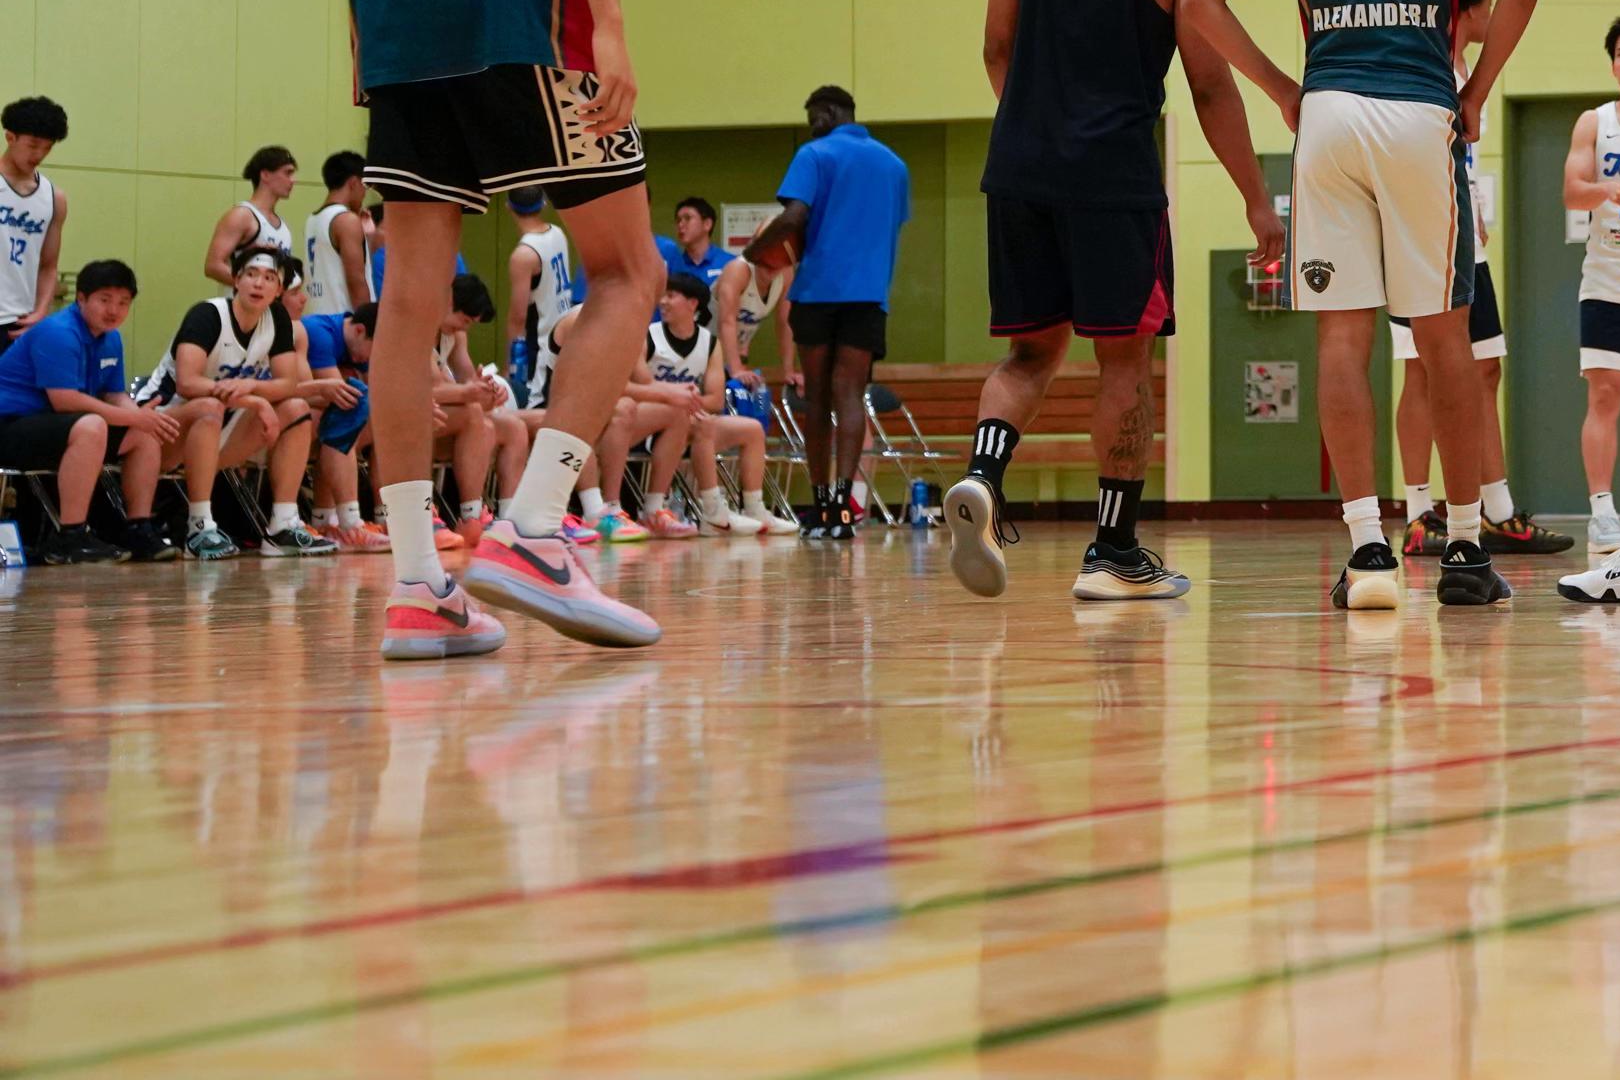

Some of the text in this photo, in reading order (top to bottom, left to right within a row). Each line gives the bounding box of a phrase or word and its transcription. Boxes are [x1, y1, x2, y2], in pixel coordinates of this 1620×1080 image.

[1312, 2, 1440, 33] ALEXANDER.K
[10, 236, 27, 266] 12
[551, 252, 571, 295] 31
